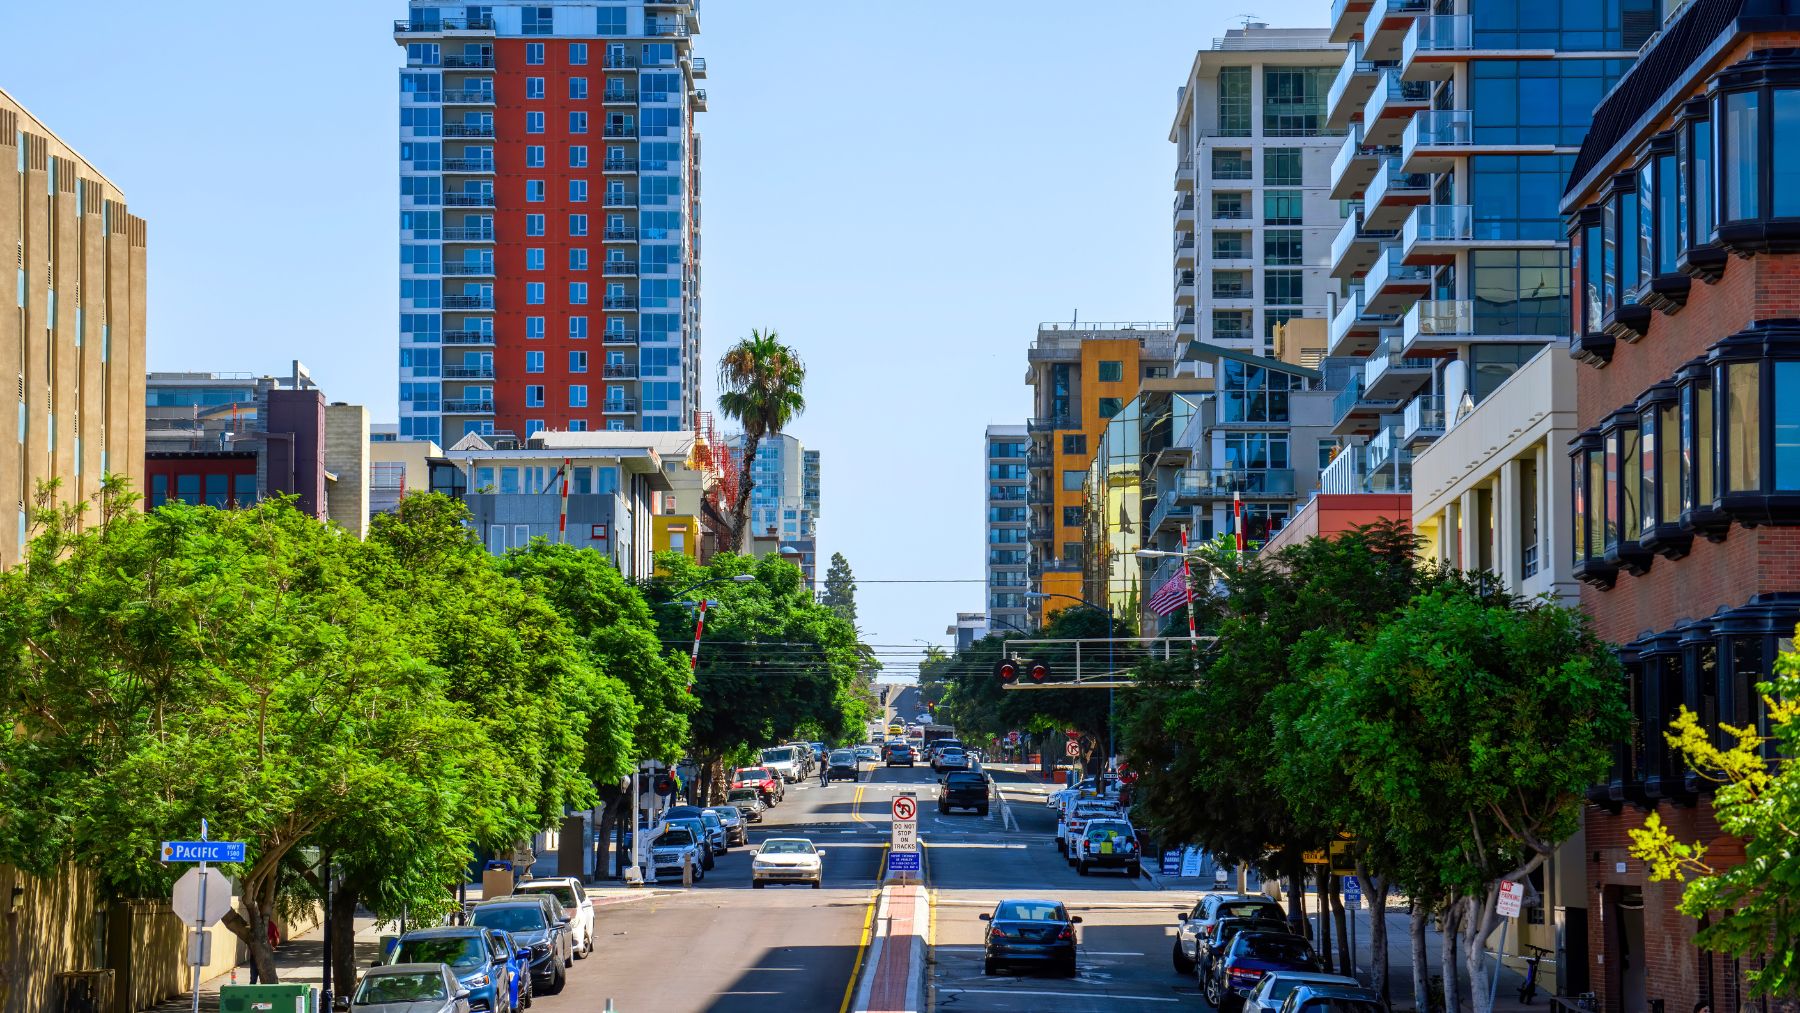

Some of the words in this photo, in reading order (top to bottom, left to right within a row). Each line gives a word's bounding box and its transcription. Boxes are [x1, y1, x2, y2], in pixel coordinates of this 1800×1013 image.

[176, 845, 219, 858] PACIFIC
[1503, 882, 1510, 890] NO
[1501, 891, 1521, 902] PARKING
